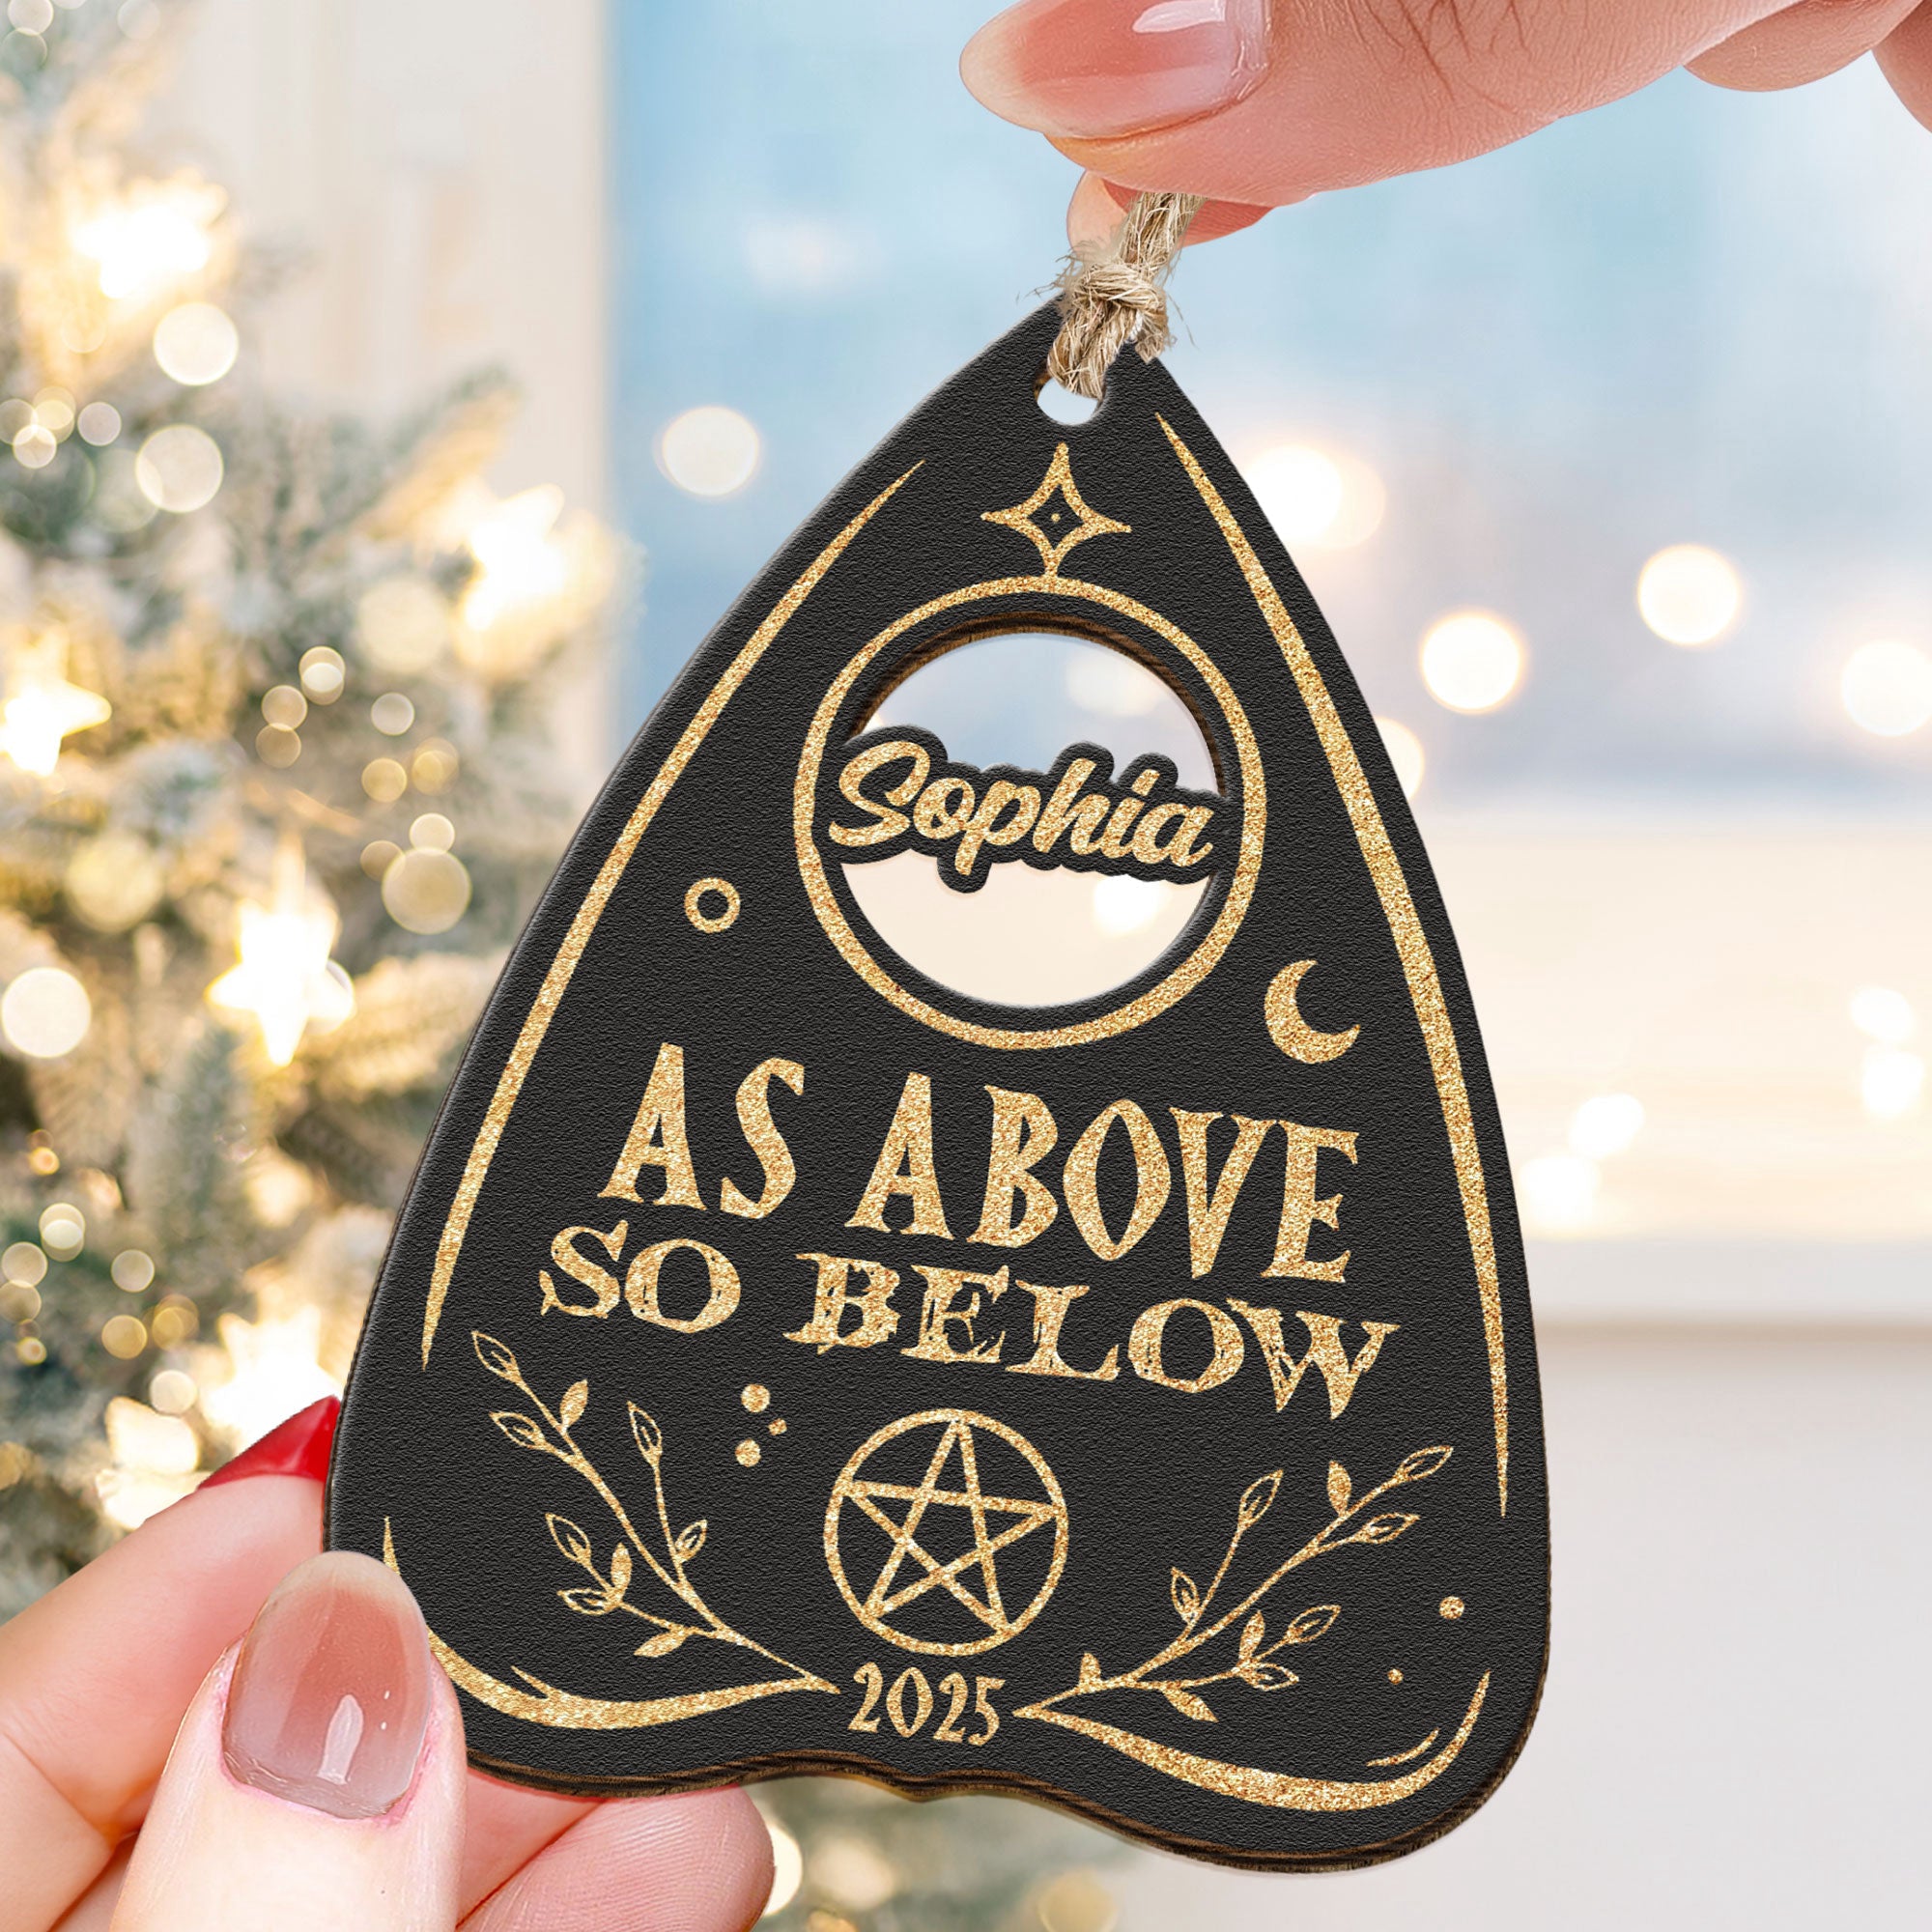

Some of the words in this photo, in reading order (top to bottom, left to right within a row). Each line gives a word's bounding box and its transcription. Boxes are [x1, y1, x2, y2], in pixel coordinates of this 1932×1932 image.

[828, 740, 1214, 876] Sophia
[596, 1042, 806, 1220] AS
[843, 1071, 1360, 1284] ABOVE
[538, 1219, 742, 1334] SO
[781, 1252, 1402, 1421] BELOW
[847, 1661, 1006, 1747] 2025
